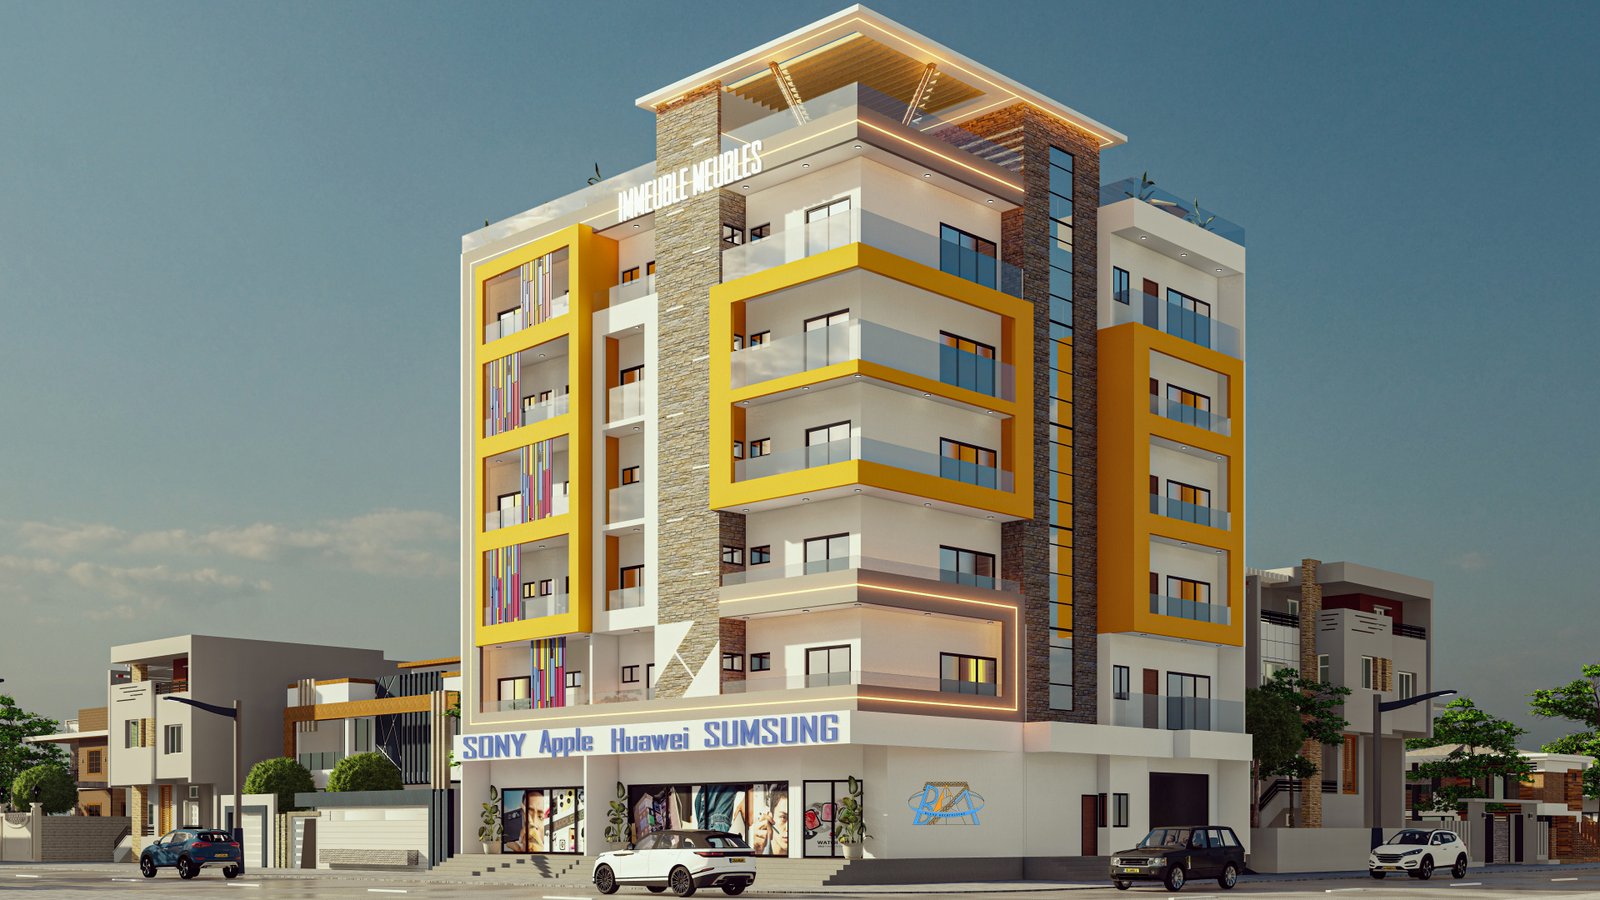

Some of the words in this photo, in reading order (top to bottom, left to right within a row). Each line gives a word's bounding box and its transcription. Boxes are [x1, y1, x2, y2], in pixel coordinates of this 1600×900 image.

[618, 167, 689, 222] IMMEUBLE
[692, 140, 762, 196] MEUBLES
[462, 733, 527, 759] SONY
[539, 728, 594, 758] Apple
[611, 727, 689, 753] Huawei
[703, 714, 839, 748] SUMSUNG
